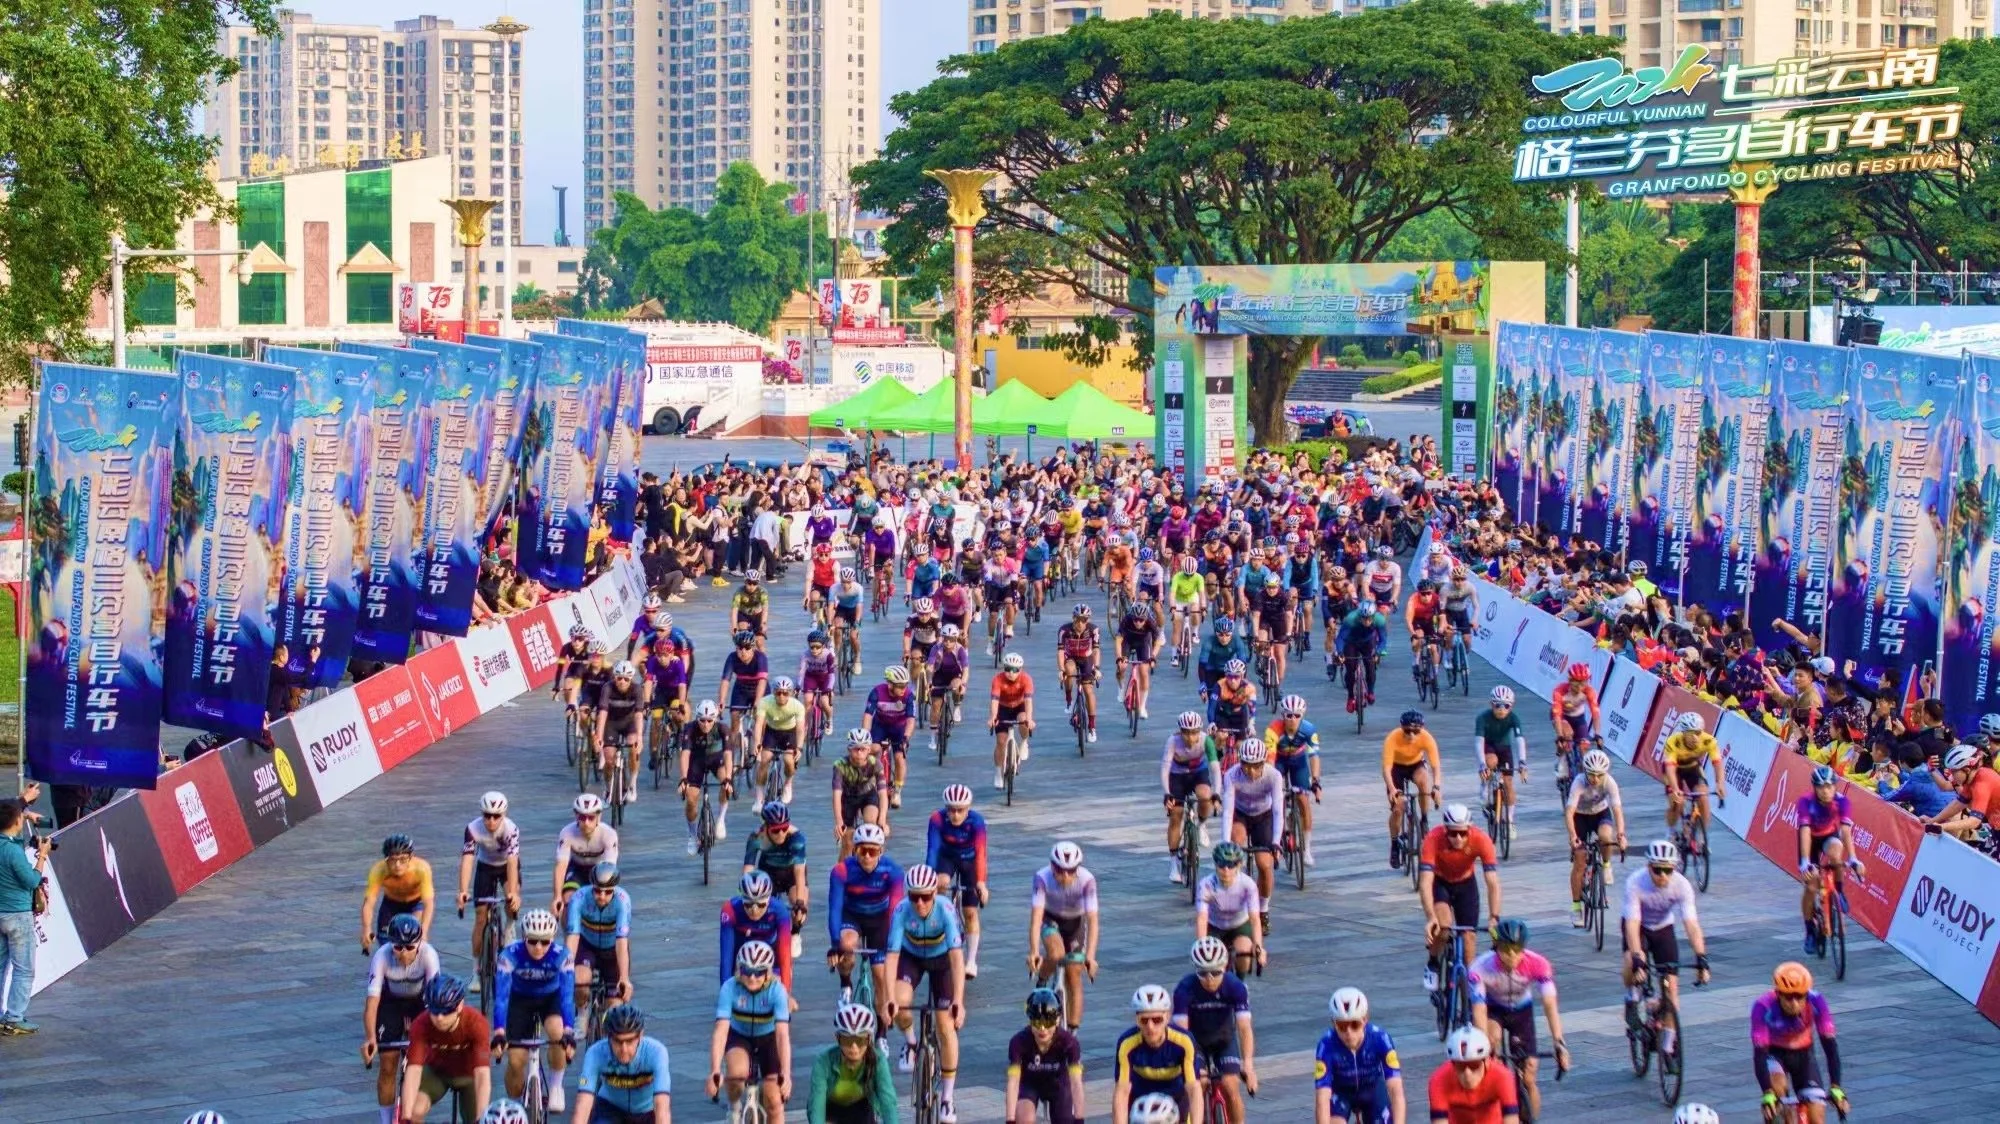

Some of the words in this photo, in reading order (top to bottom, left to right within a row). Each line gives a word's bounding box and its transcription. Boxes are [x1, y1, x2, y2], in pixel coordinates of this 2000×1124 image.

[660, 366, 733, 379] 国家应急通信
[876, 362, 915, 374] 中国移动
[206, 455, 220, 500] COLOURFUL
[1880, 440, 1894, 482] COLOURFUL
[78, 475, 92, 525] COLOURFUL
[1876, 484, 1889, 512] YUNNAN
[204, 501, 217, 532] YUNNAN
[301, 420, 340, 645] 七彩云南格兰芬多自行车节
[1561, 505, 1570, 530] FESTIVAL
[75, 527, 88, 562] YUNNAN
[535, 524, 544, 552] FESTIVAL
[1604, 521, 1613, 549] FESTIVAL
[1655, 537, 1665, 566] FESTIVAL
[1870, 519, 1884, 573] GRANFONDO
[1878, 421, 1930, 655] 七彩云南格兰芬多自行车节
[198, 537, 213, 596] GRANFONDO
[209, 434, 256, 685] 七彩云南格兰芬多自行车节
[416, 560, 427, 590] FESTIVAL
[1719, 559, 1729, 591] FESTIVAL
[70, 570, 84, 635] GRANFONDO
[86, 451, 132, 732] 七彩云南格兰芬多自行车节
[1786, 585, 1797, 620] FESTIVAL
[1866, 574, 1879, 610] CYCLING
[196, 597, 209, 637] CYCLING
[284, 605, 296, 641] FESTIVAL
[1861, 612, 1874, 650] FESTIVAL
[1981, 615, 1995, 656] CYCLING
[66, 637, 80, 680] CYCLING
[191, 638, 205, 679] FESTIVAL
[438, 675, 464, 700] JAKROO
[1976, 657, 1990, 701] FESTIVAL
[64, 682, 78, 729] FESTIVAL
[323, 722, 359, 757] RUDY
[332, 744, 362, 765] PROJECT
[254, 762, 278, 793] SIDAS
[188, 818, 213, 846] COFFEE
[1782, 803, 1799, 830] JAK
[1934, 886, 1995, 942] RUDY
[1933, 920, 1980, 956] PROJECT
